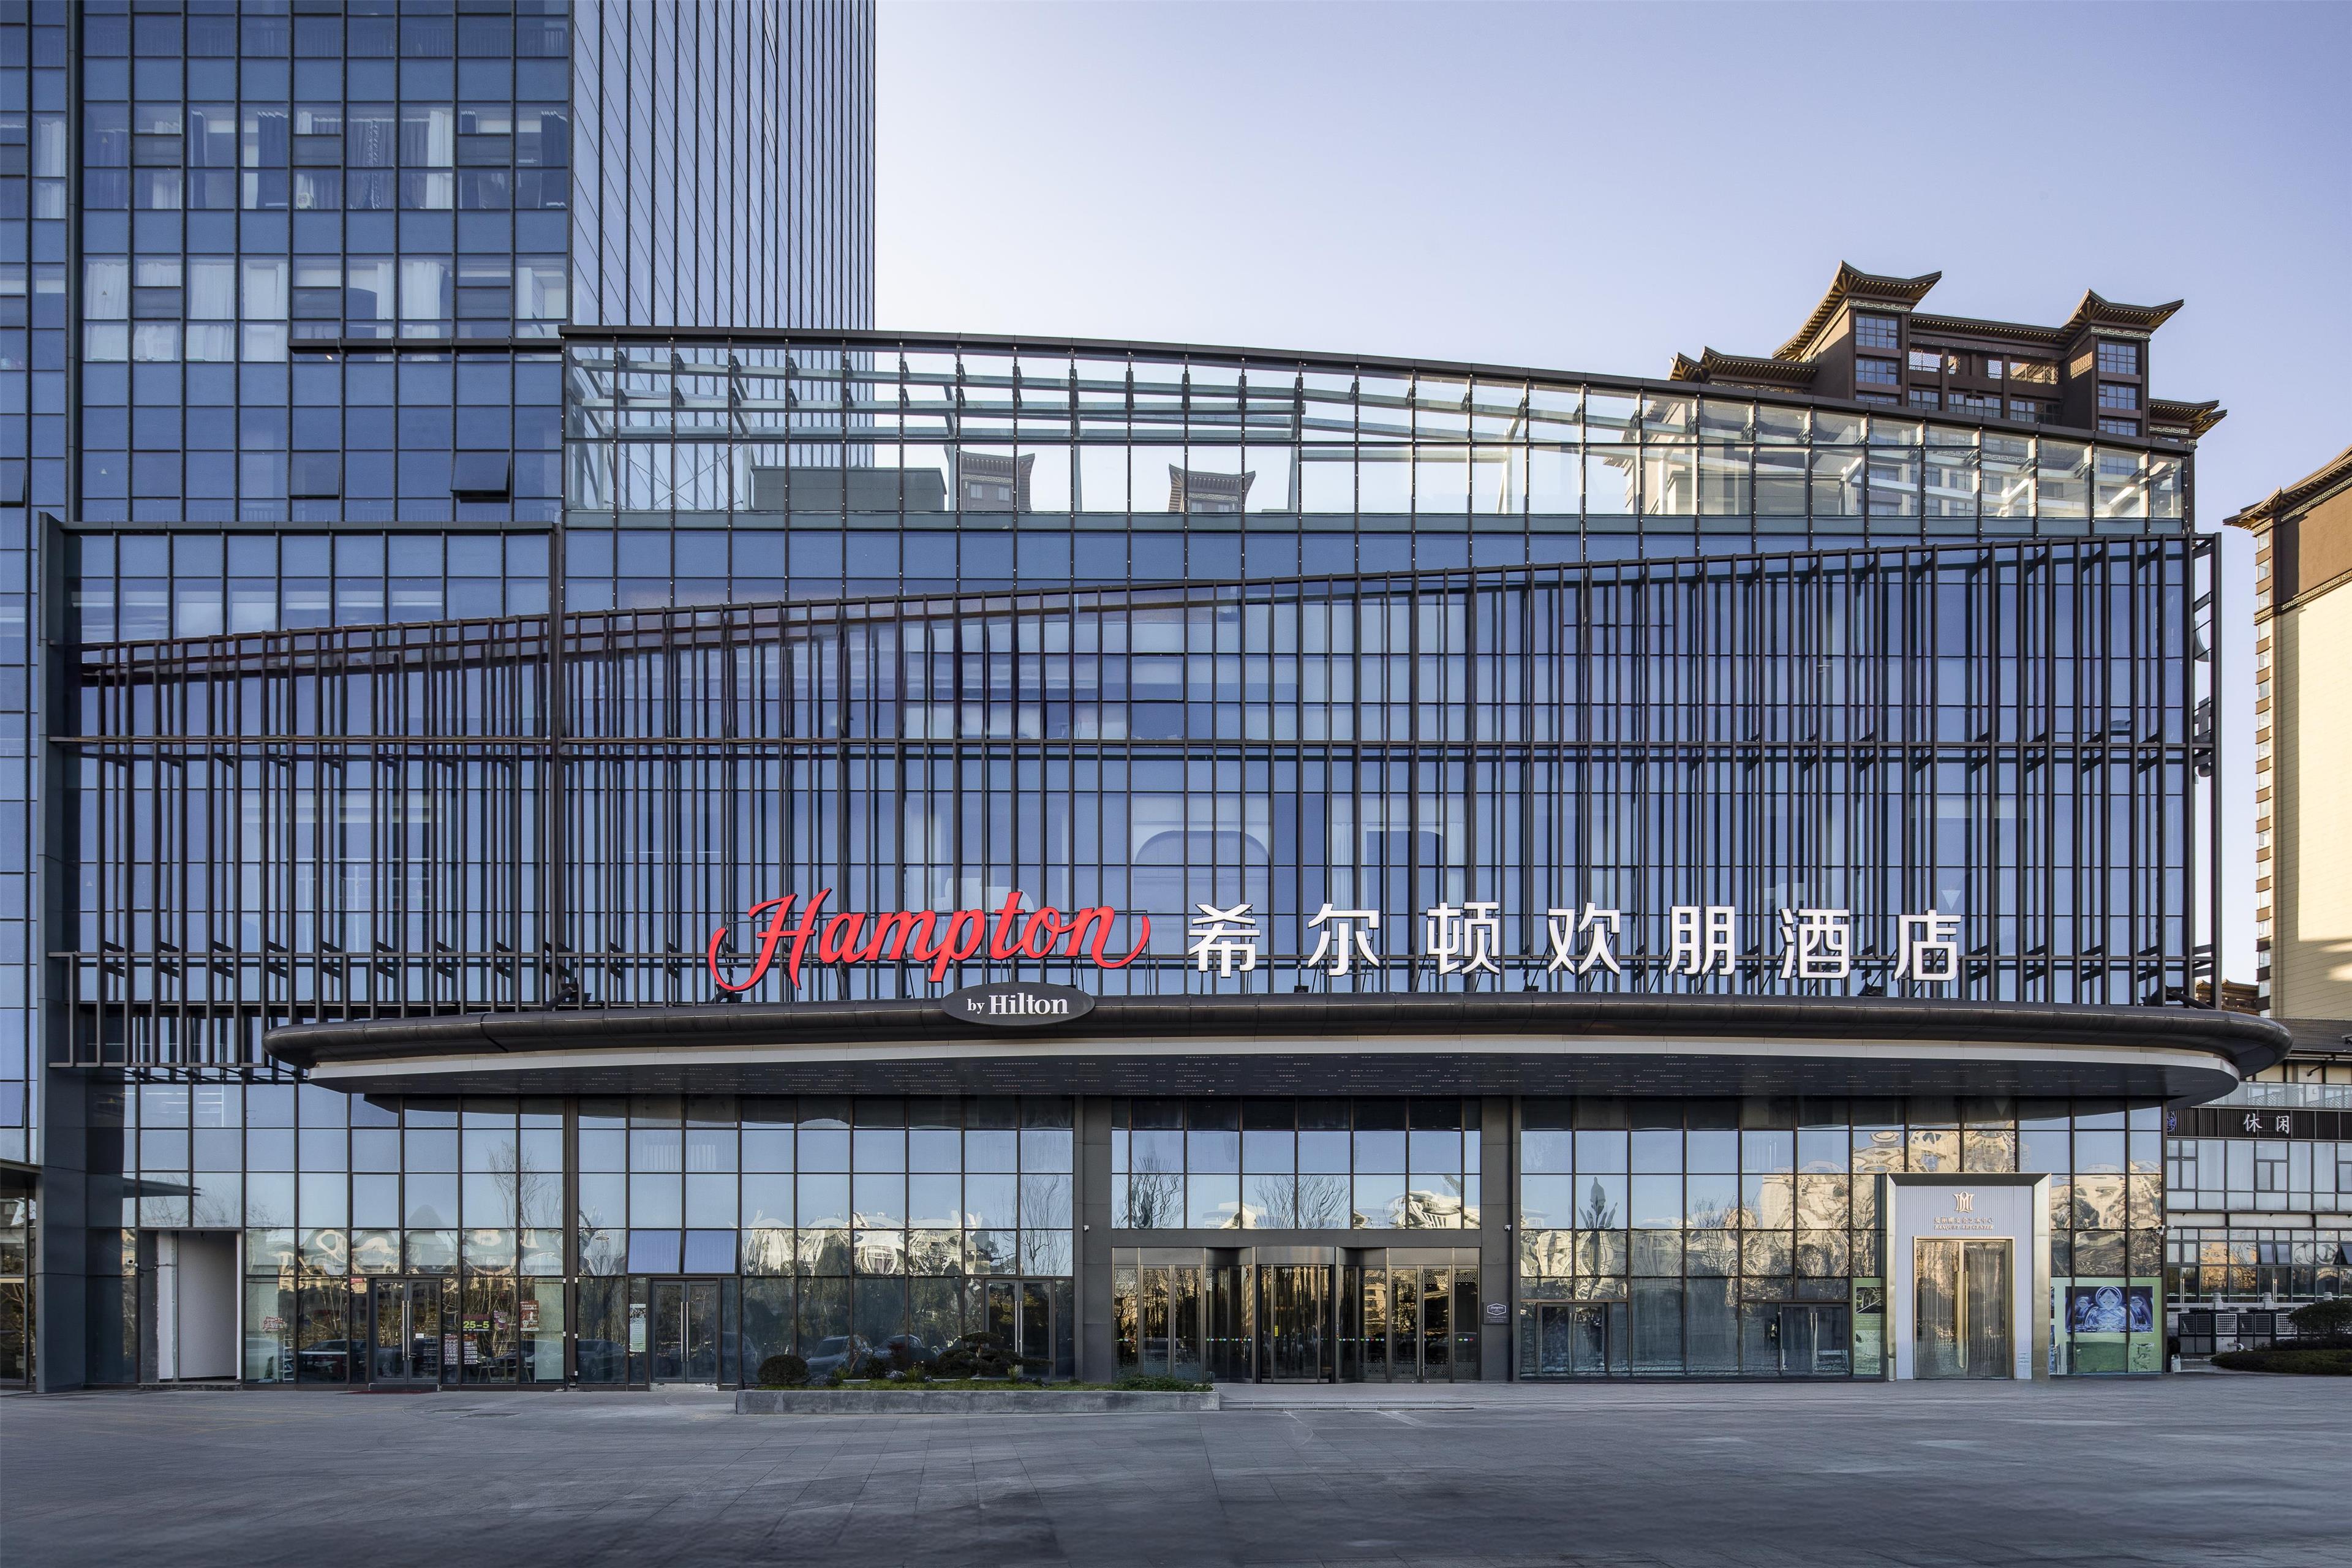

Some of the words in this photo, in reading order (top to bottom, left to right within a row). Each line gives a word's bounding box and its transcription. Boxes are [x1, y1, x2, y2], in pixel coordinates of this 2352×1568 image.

[709, 887, 1151, 993] Hampton
[1188, 901, 1962, 982] 希尔顿欢朋酒店
[967, 998, 985, 1014] by
[989, 992, 1069, 1015] Hilton
[2242, 1112, 2290, 1134] 休闲
